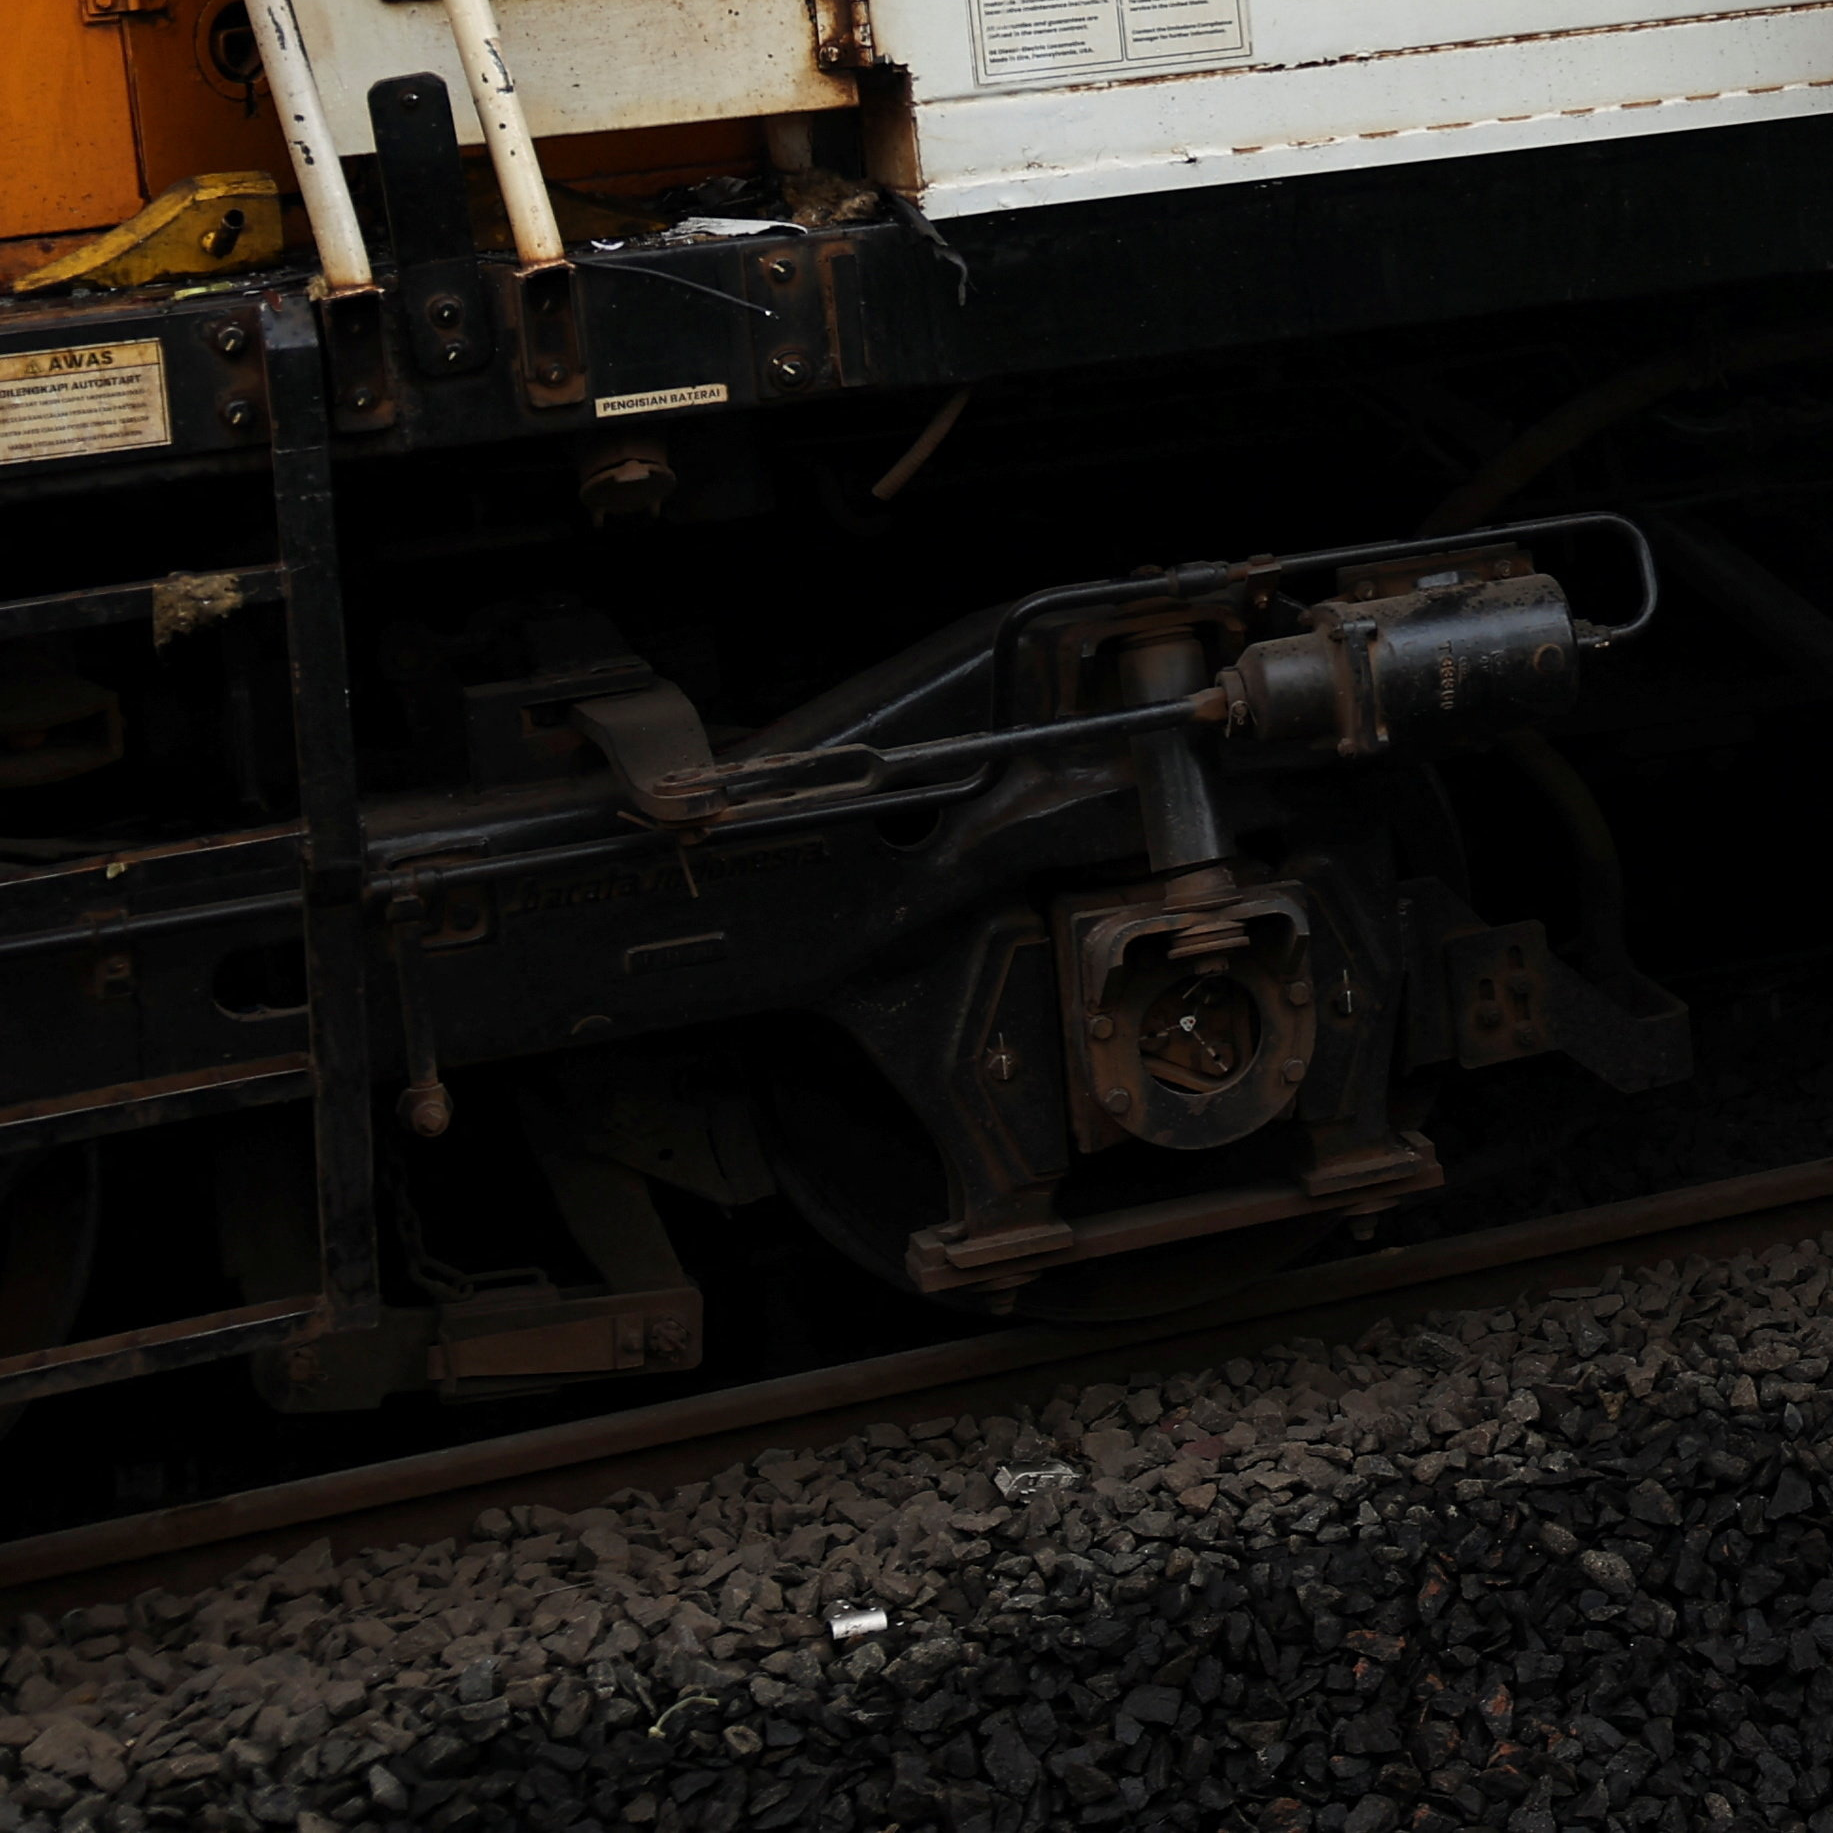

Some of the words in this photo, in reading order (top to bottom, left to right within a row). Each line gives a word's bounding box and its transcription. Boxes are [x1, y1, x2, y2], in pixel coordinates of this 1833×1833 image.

[48, 350, 114, 372] AWAS
[0, 383, 69, 399] DILENGKAPI
[71, 374, 142, 391] AUTOSTART
[602, 394, 668, 412] PENGISIAN
[670, 388, 720, 404] BATERAI
